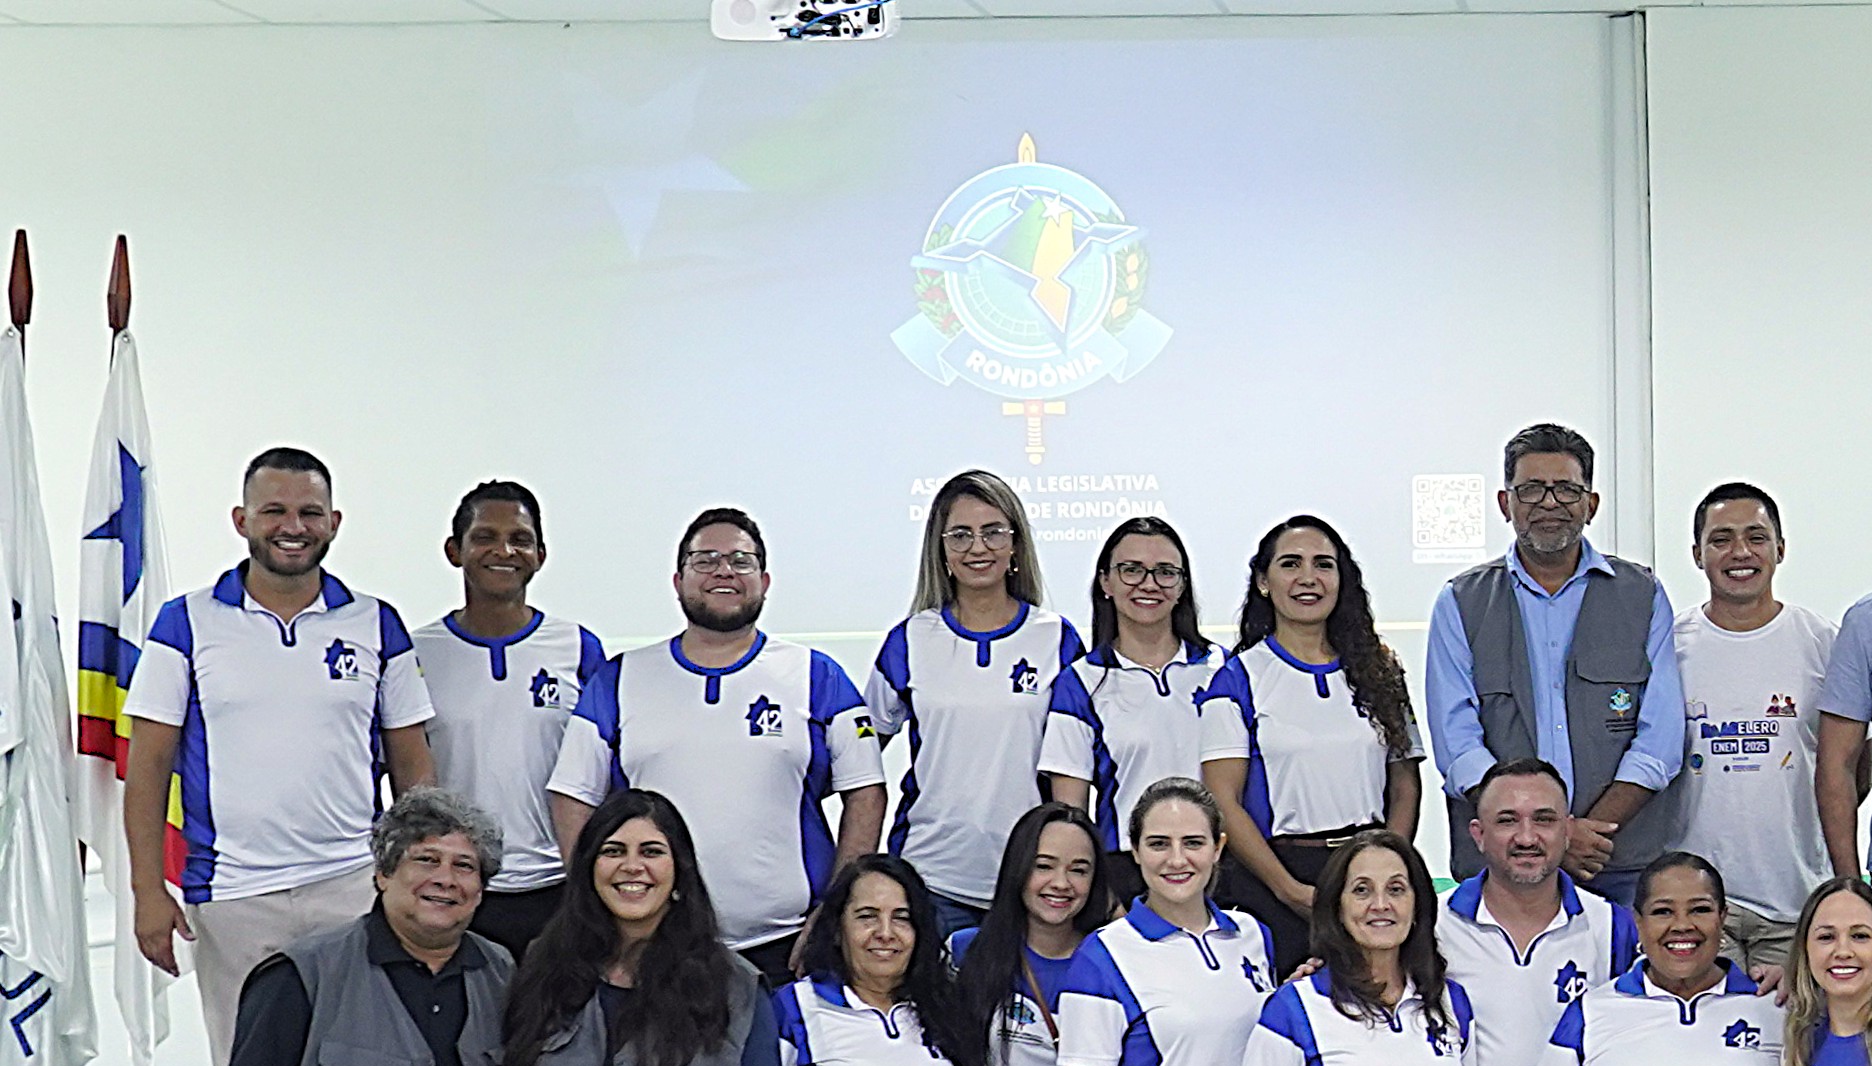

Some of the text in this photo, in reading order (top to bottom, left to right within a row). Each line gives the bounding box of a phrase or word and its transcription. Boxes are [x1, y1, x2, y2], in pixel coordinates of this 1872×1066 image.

[966, 350, 1101, 388] RONDÔNIA
[1037, 473, 1159, 492] LEGISLATIVA
[1057, 497, 1167, 518] RONDÔNIA
[335, 654, 356, 675] 42
[1018, 672, 1037, 692] 42
[538, 684, 559, 706] 42
[756, 710, 780, 733] 42
[1713, 741, 1767, 752] ENEM 2025
[1565, 978, 1587, 1001] 42
[1734, 1032, 1759, 1047] 42
